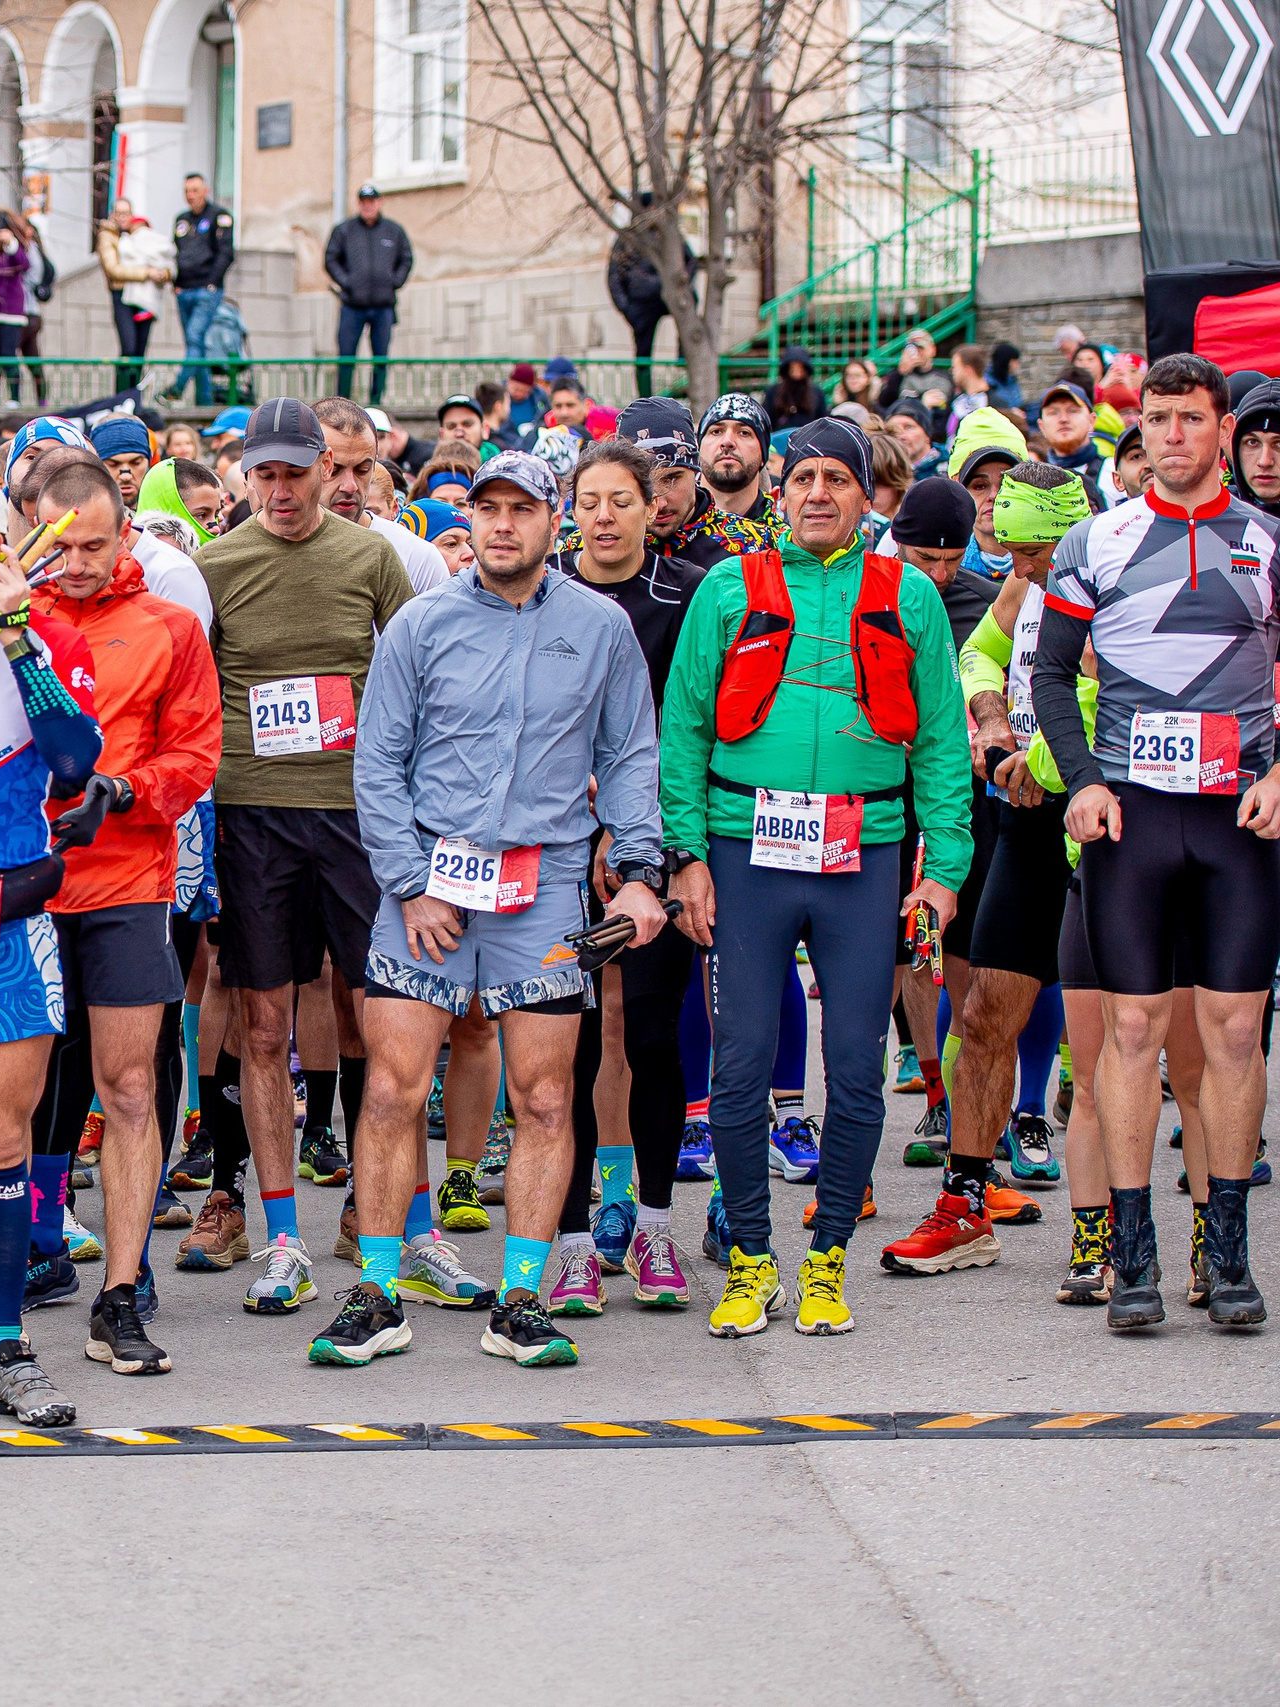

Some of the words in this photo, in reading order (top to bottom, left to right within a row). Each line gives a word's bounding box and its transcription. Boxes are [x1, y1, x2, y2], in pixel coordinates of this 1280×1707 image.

[1229, 540, 1259, 554] BUL
[7, 611, 30, 625] EKI
[737, 639, 769, 655] SALOMON
[558, 653, 580, 661] TRAIL
[945, 641, 960, 683] SALOMON
[282, 683, 296, 692] 22K
[257, 700, 312, 729] 2143
[1164, 716, 1179, 725] 22K
[257, 729, 285, 739] MARKOVO
[285, 727, 300, 735] TRAIL
[321, 726, 340, 738] STEP
[1132, 735, 1195, 762] 2363
[1133, 763, 1161, 771] MARKOVO
[1161, 763, 1177, 772] TRAIL
[1200, 758, 1224, 773] EVERY
[1200, 768, 1220, 780] STEP
[755, 815, 820, 842] ABBAS
[757, 839, 786, 849] MARKOVO
[786, 842, 801, 851] TRAIL
[823, 838, 847, 852] EVERY
[823, 848, 843, 860] STEP
[434, 853, 496, 882] 2286
[433, 874, 461, 888] MARKOVO
[461, 881, 476, 891] TRAIL
[712, 953, 720, 1015] MALOJA
